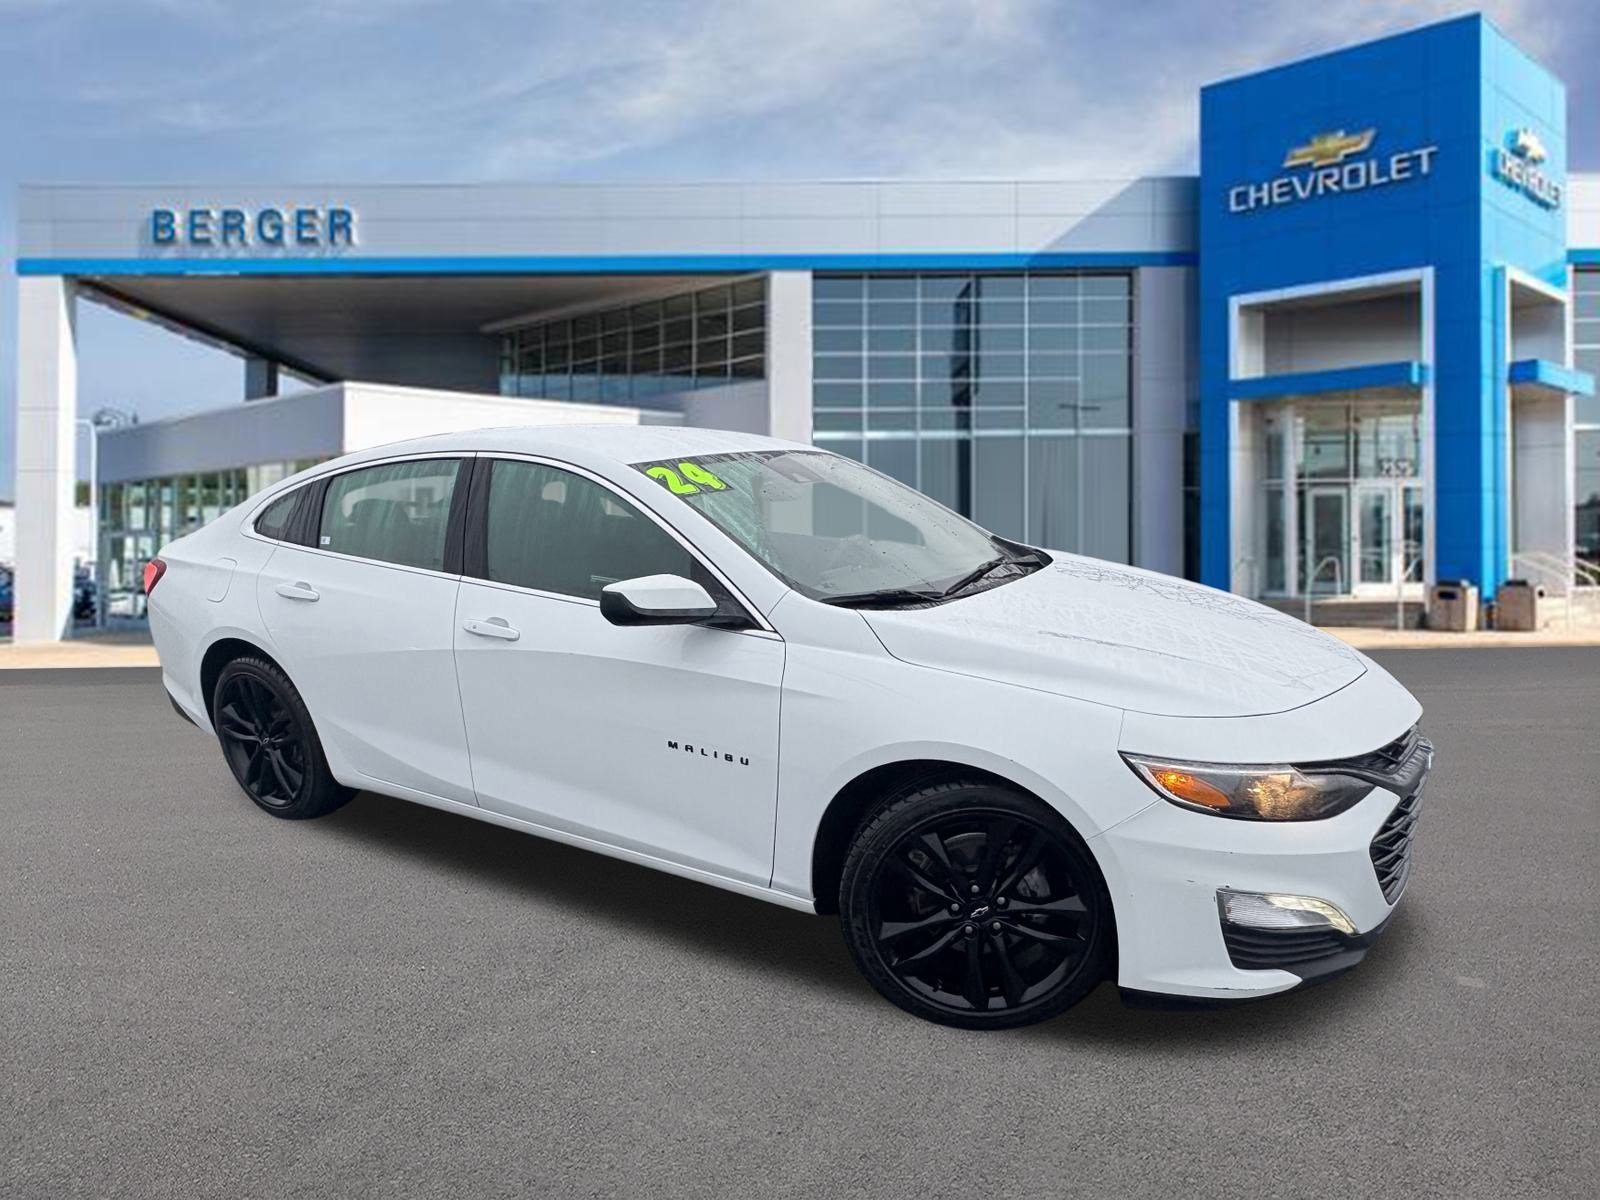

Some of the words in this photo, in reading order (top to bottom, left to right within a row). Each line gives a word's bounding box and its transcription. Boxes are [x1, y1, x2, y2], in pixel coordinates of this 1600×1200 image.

[1229, 146, 1438, 212] CHEVROLET
[152, 208, 355, 246] BERGER
[645, 462, 727, 495] 24
[667, 740, 749, 766] MALIBU
